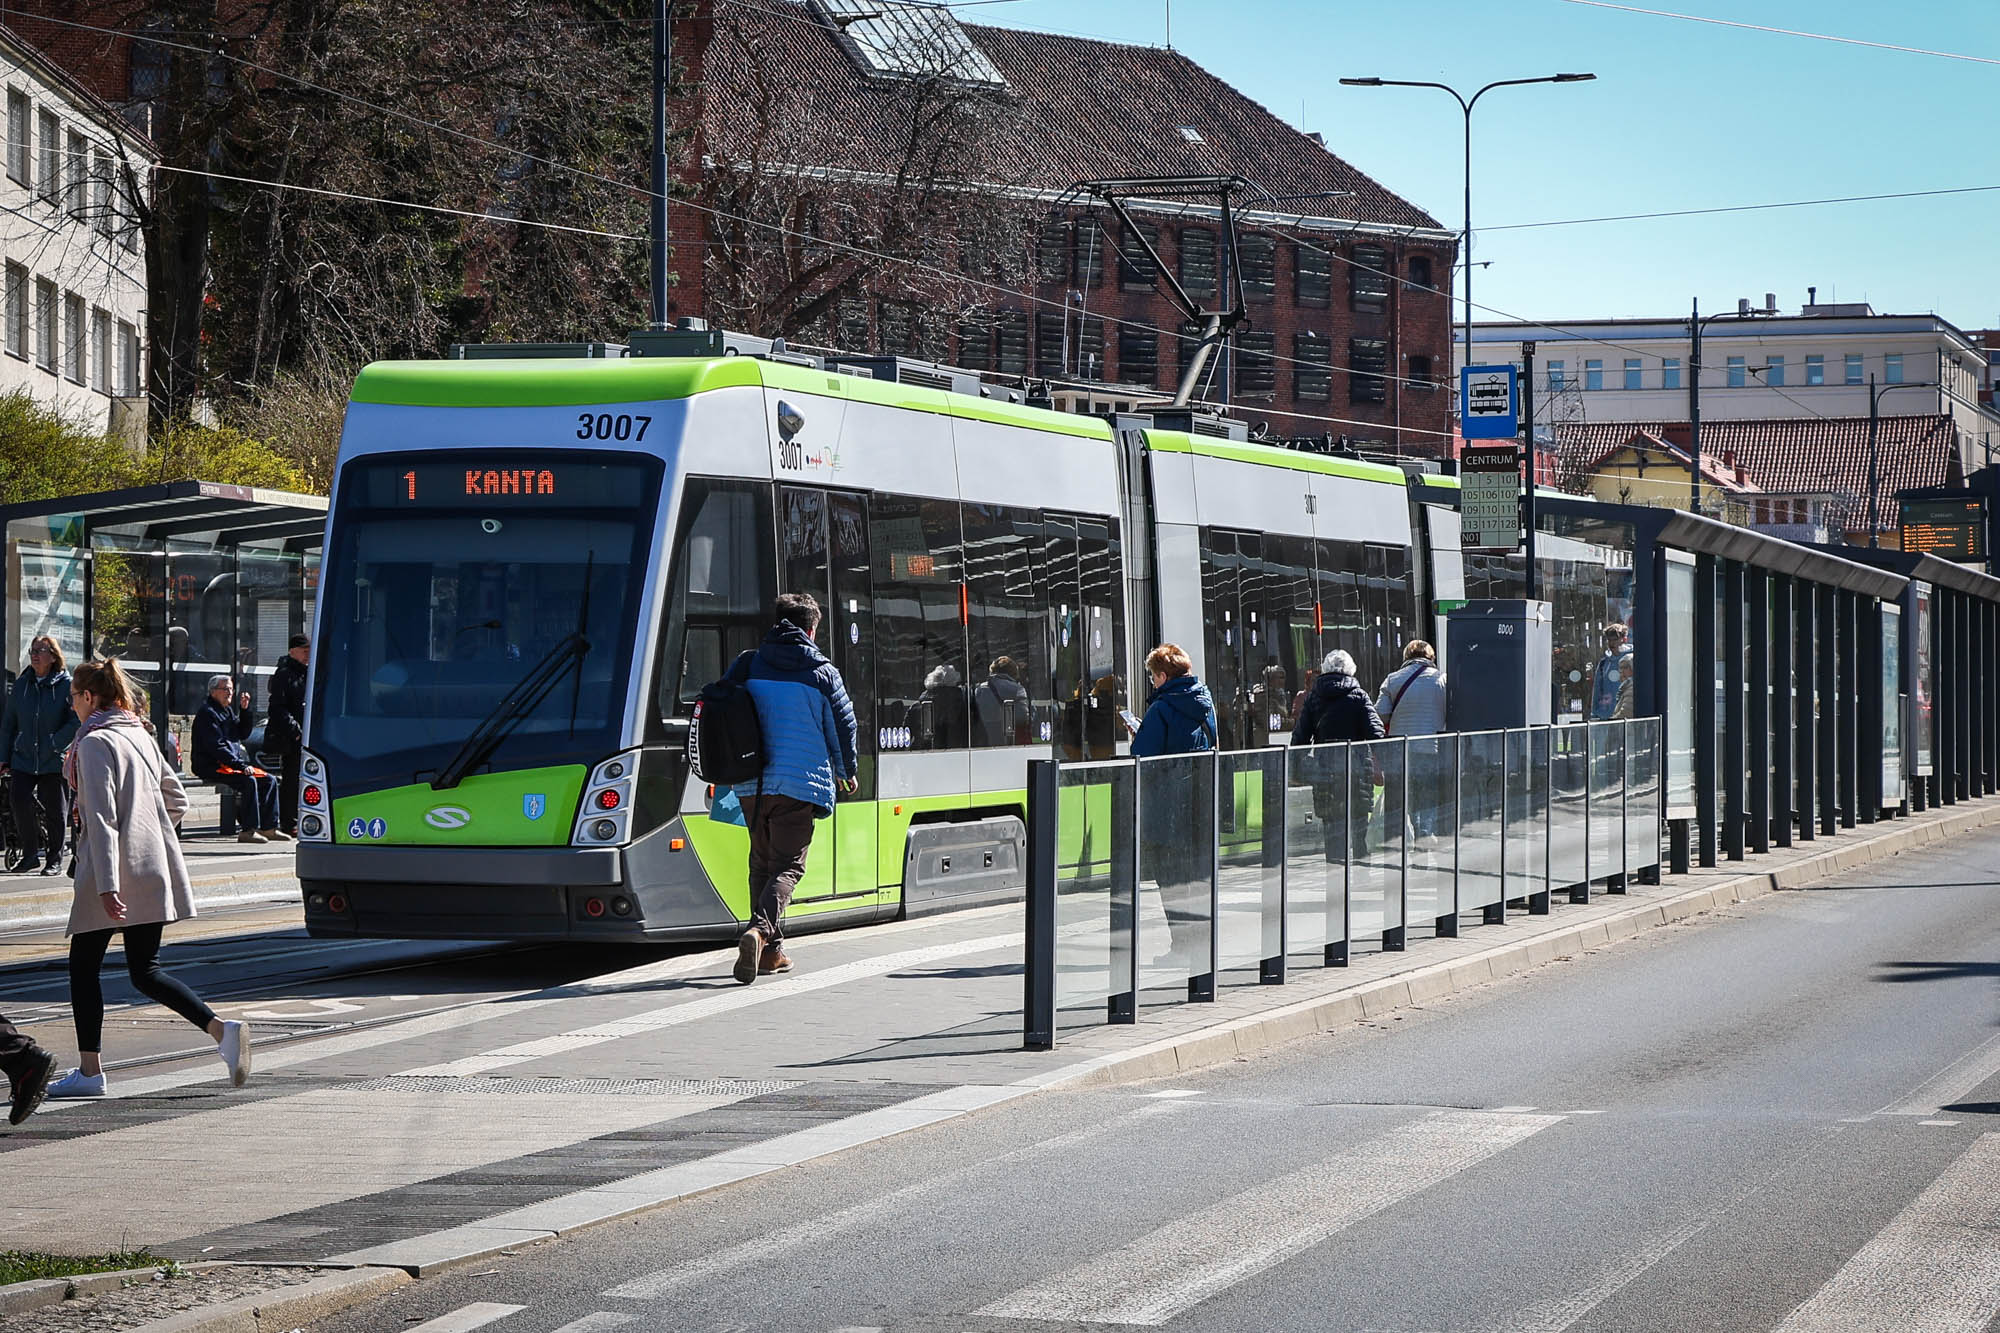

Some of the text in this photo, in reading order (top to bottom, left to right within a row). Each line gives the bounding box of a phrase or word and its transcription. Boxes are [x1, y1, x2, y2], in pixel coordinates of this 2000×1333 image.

[1523, 344, 1534, 352] 02
[577, 413, 651, 442] 3007
[779, 440, 802, 471] 3007
[1465, 455, 1513, 465] CENTRUM
[403, 470, 554, 500] 1 KANTA
[1468, 475, 1516, 485] 1 5 101
[1463, 490, 1516, 500] 105 106 107
[1463, 504, 1516, 514] 109 110 111
[1463, 519, 1517, 529] 113 117 128
[1462, 533, 1479, 543] N01
